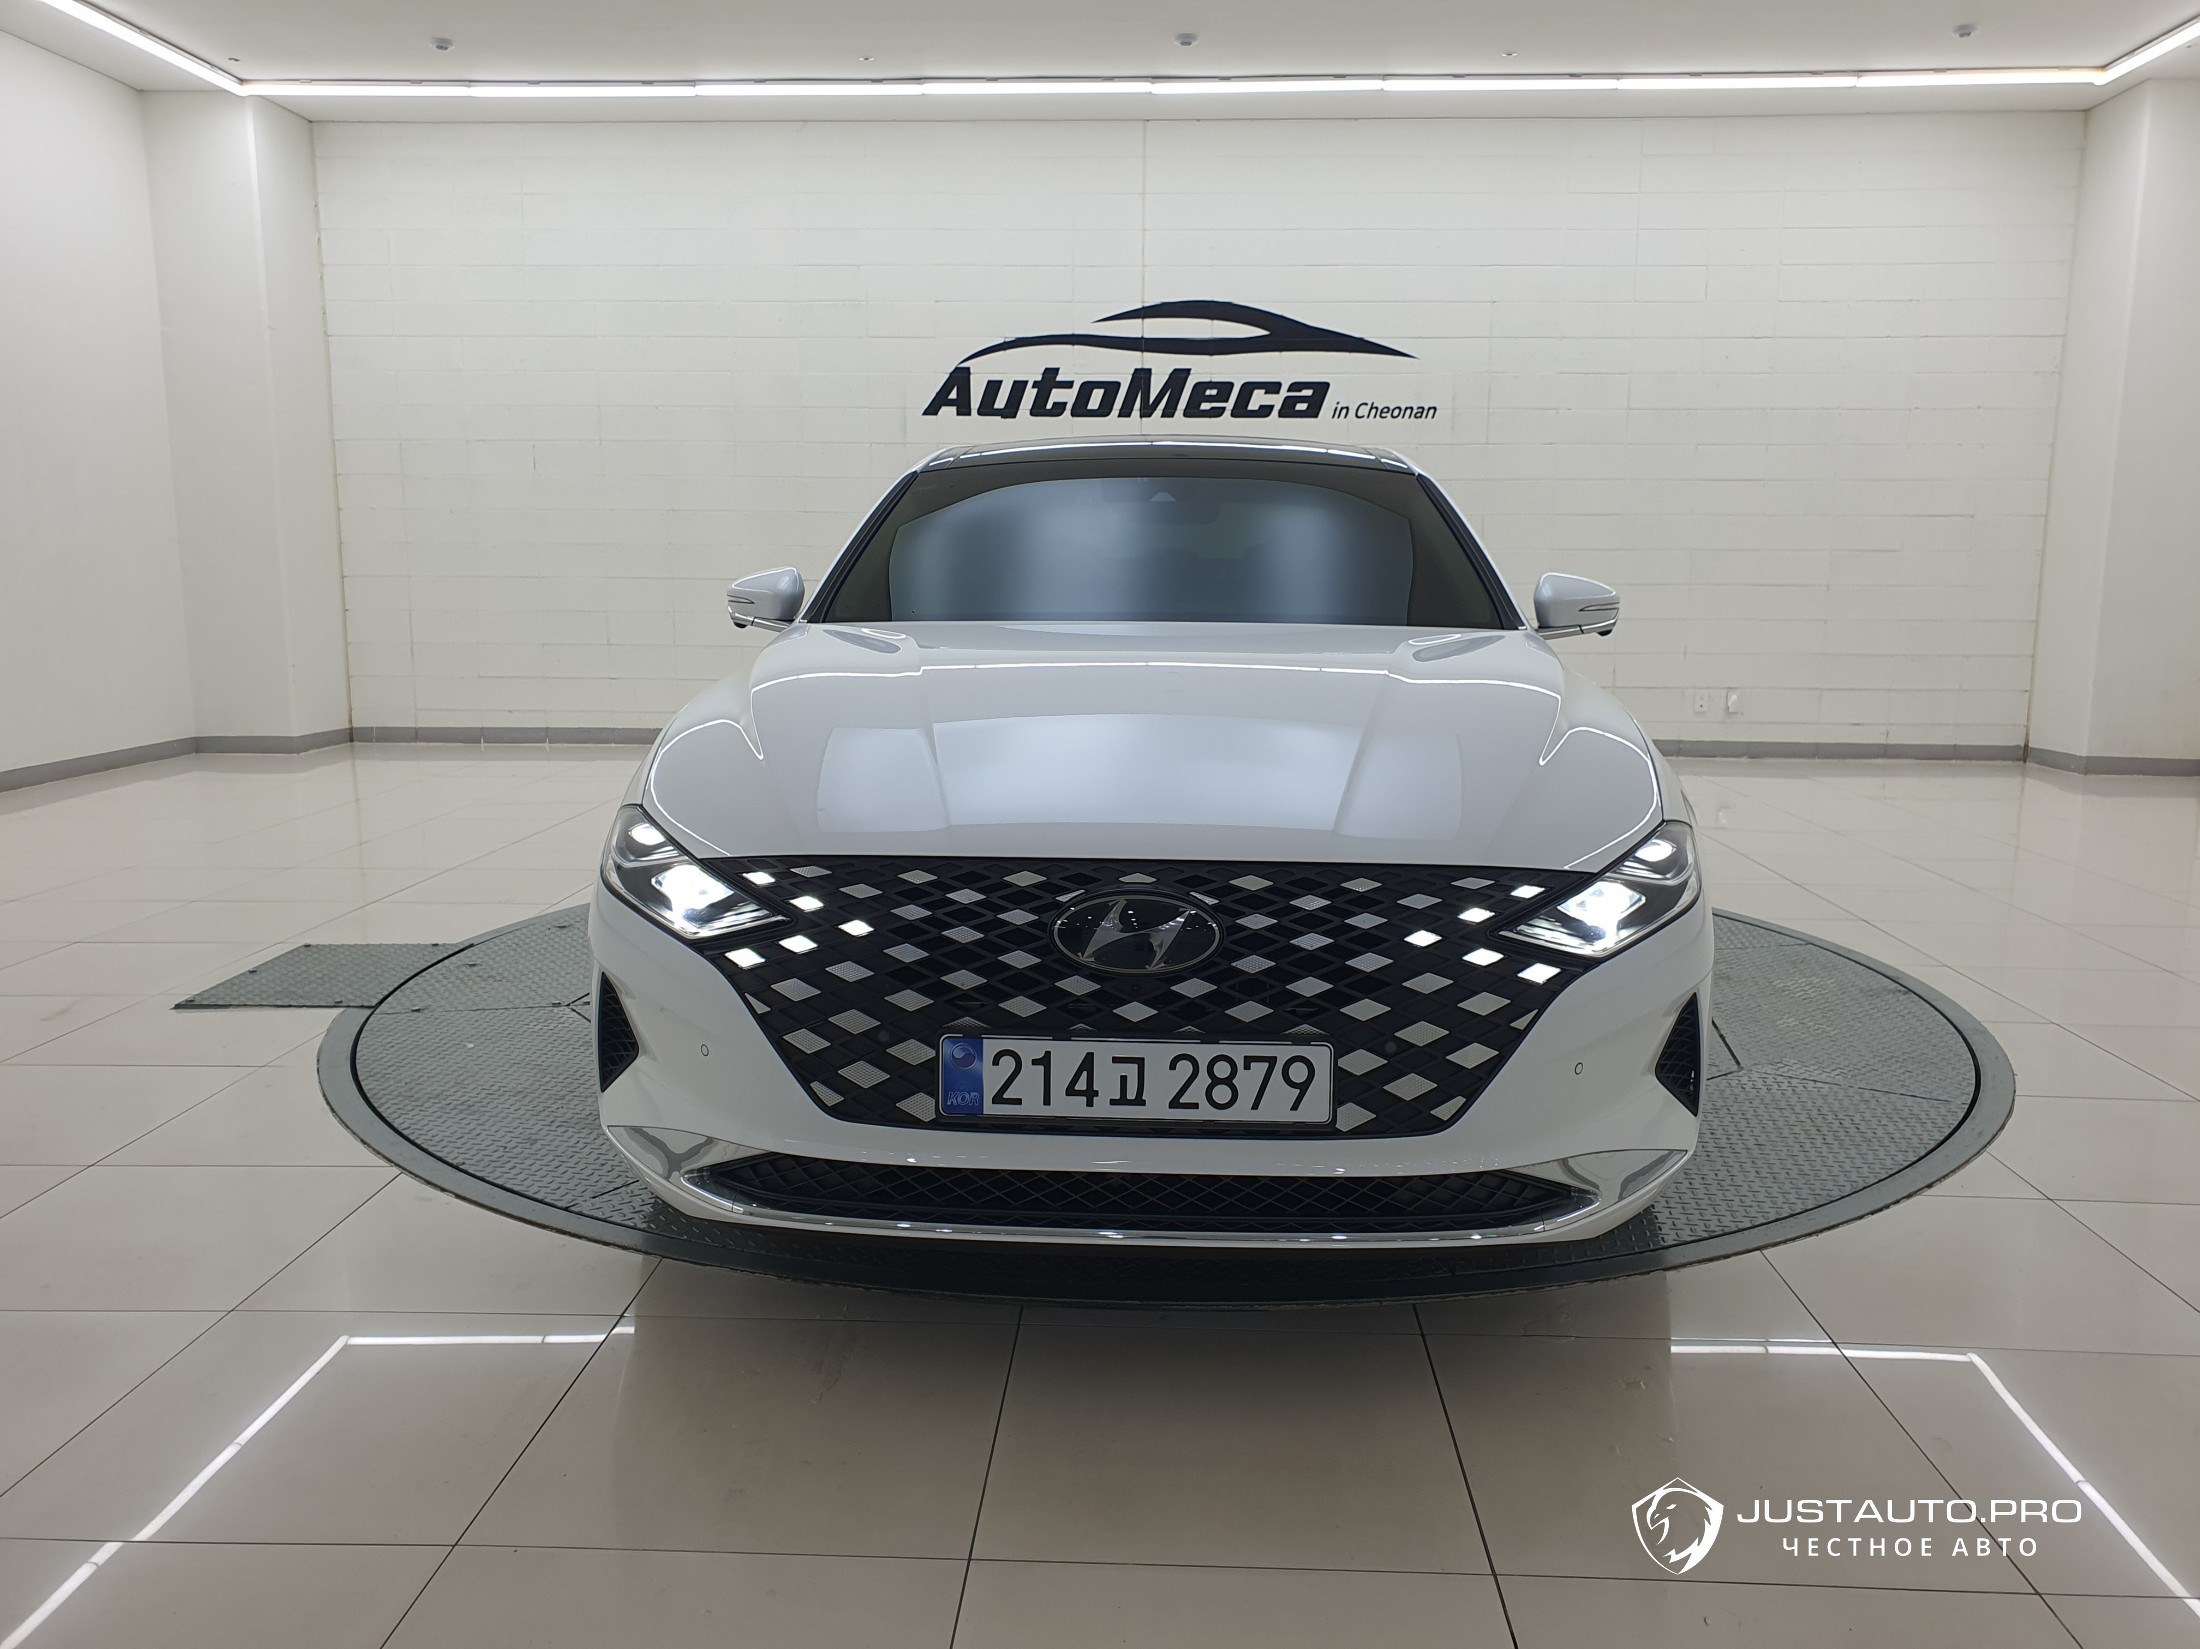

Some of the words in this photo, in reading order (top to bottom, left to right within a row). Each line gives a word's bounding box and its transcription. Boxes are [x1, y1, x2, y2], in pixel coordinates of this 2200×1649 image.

[921, 366, 1331, 420] AutoMeca
[1331, 402, 1350, 420] in
[1354, 402, 1438, 420] Cheonan
[946, 1091, 980, 1106] KOR
[991, 1048, 1147, 1108] 214고
[1168, 1053, 1316, 1112] 2879
